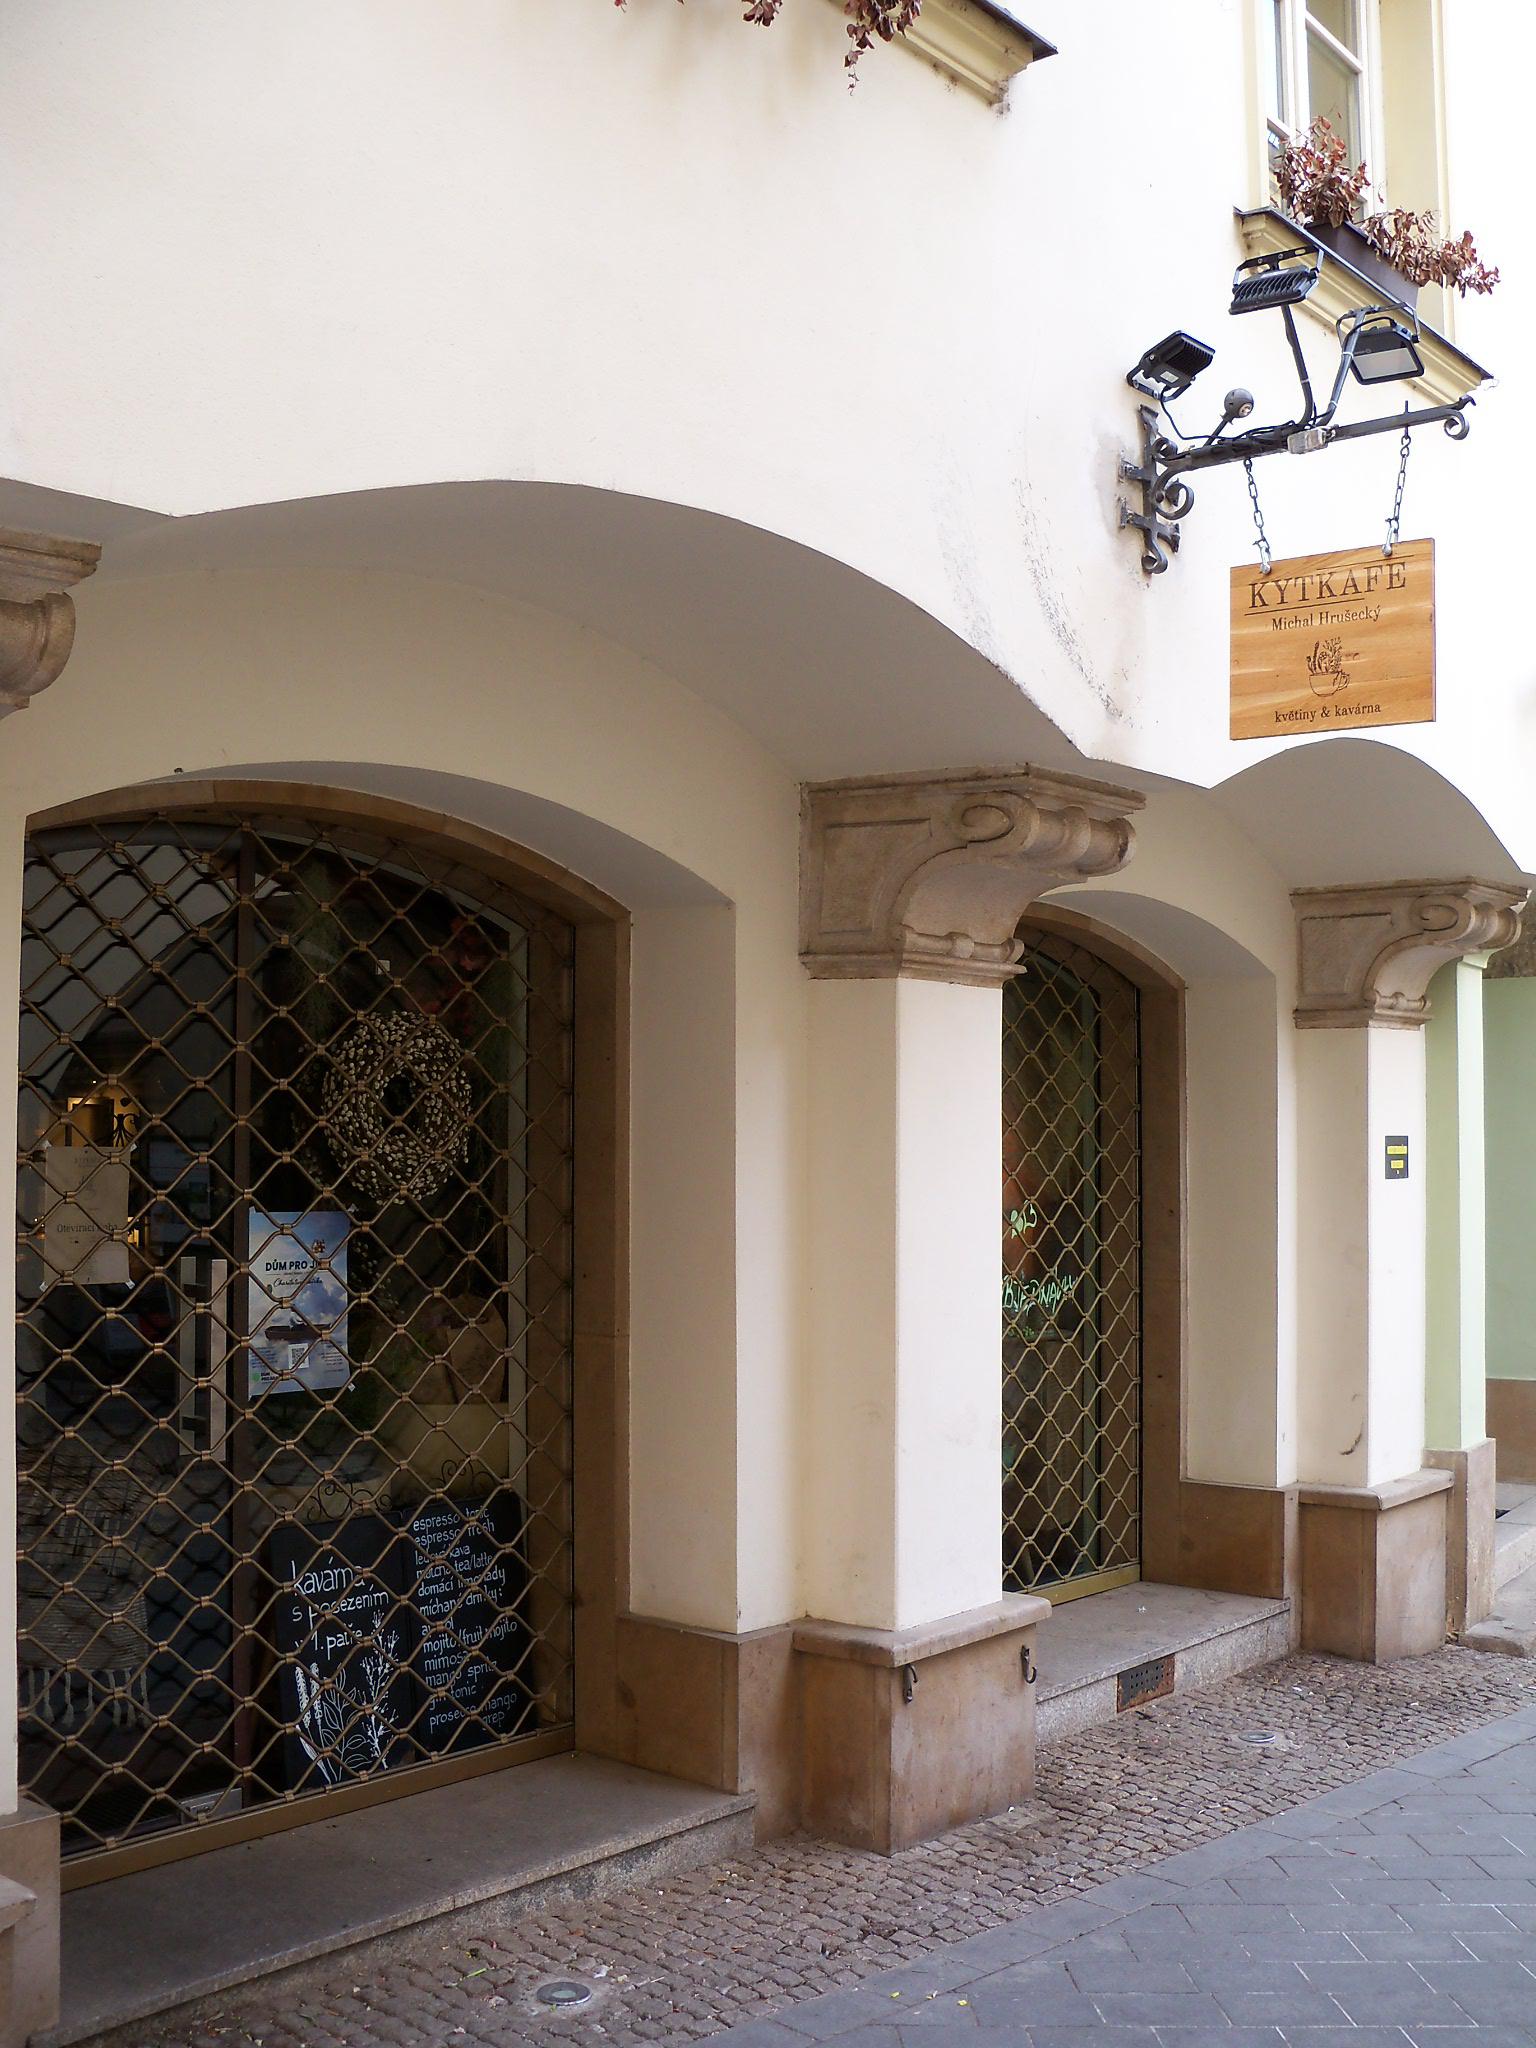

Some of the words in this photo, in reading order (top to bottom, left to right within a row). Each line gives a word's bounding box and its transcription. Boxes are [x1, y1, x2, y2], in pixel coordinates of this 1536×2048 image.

[1249, 562, 1406, 609] KYTKAFE
[1272, 613, 1314, 631] Michal
[1319, 605, 1381, 626] Hrušecký
[1274, 708, 1316, 723] květiny
[1320, 706, 1331, 718] &
[1334, 703, 1381, 718] kavárna
[265, 1259, 286, 1271] DŮM
[289, 1261, 308, 1270] PRO
[413, 1513, 460, 1534] espresso
[414, 1528, 462, 1553] espresso
[418, 1575, 454, 1597] domácí
[292, 1606, 303, 1622] s
